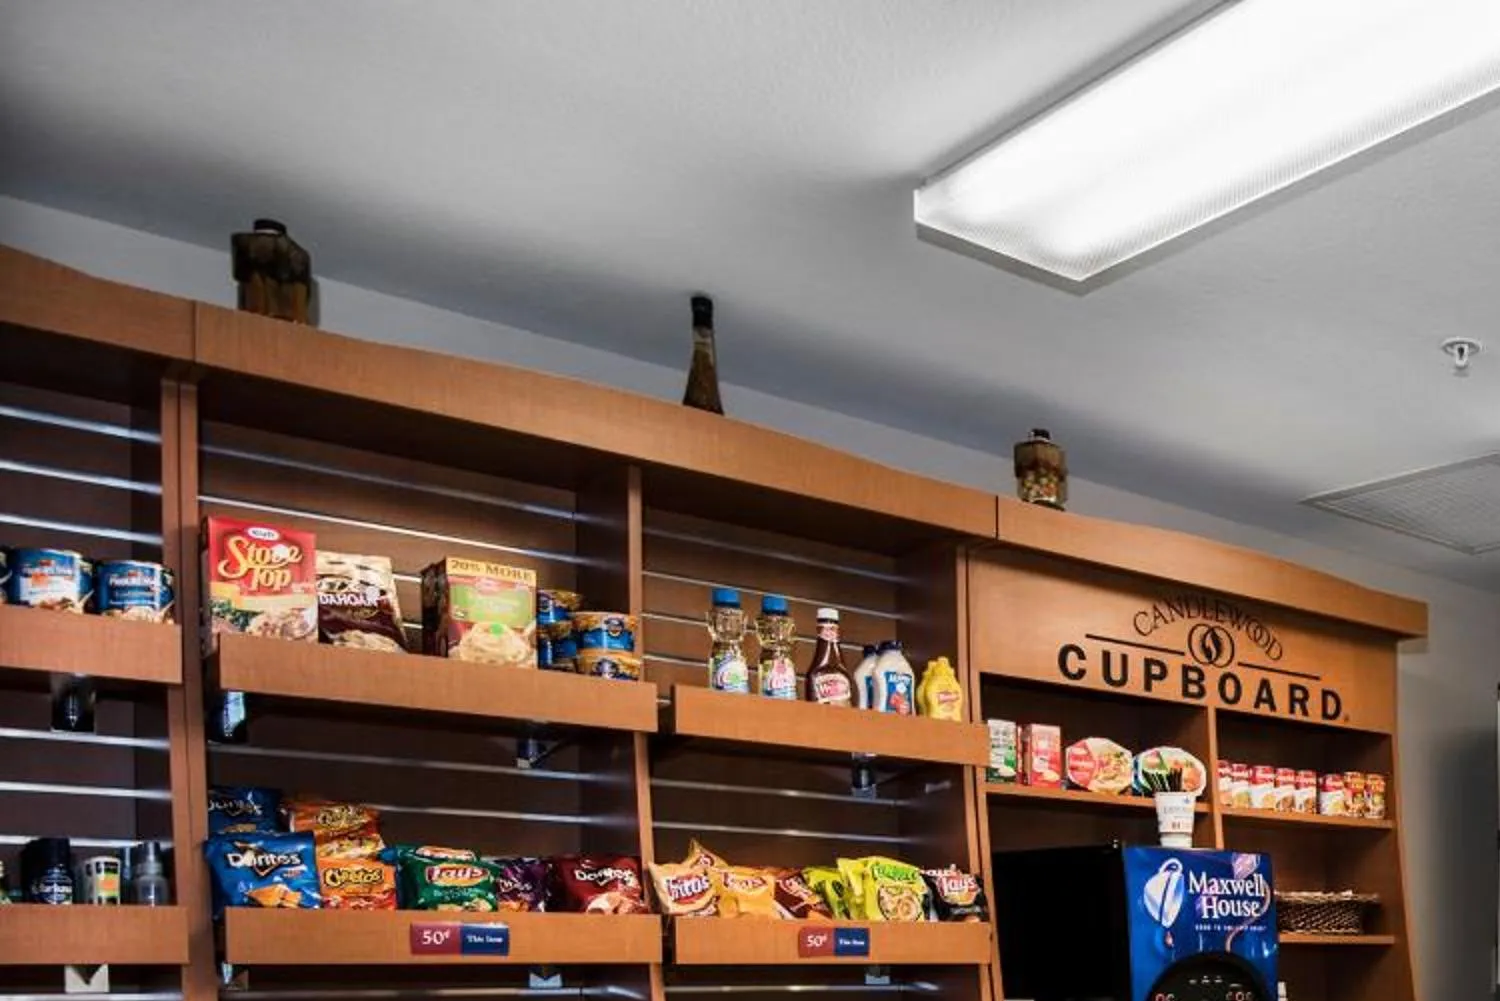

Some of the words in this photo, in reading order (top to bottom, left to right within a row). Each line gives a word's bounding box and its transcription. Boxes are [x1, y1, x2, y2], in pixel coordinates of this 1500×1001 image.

[247, 566, 292, 592] Top
[1133, 597, 1284, 662] CANDLEWOOD
[1058, 644, 1342, 721] CUPBOARD
[228, 852, 301, 868] Doritos
[324, 867, 384, 885] Cheetos
[574, 867, 634, 886] Doritos
[1188, 870, 1265, 897] Maxwell
[1201, 896, 1261, 919] House
